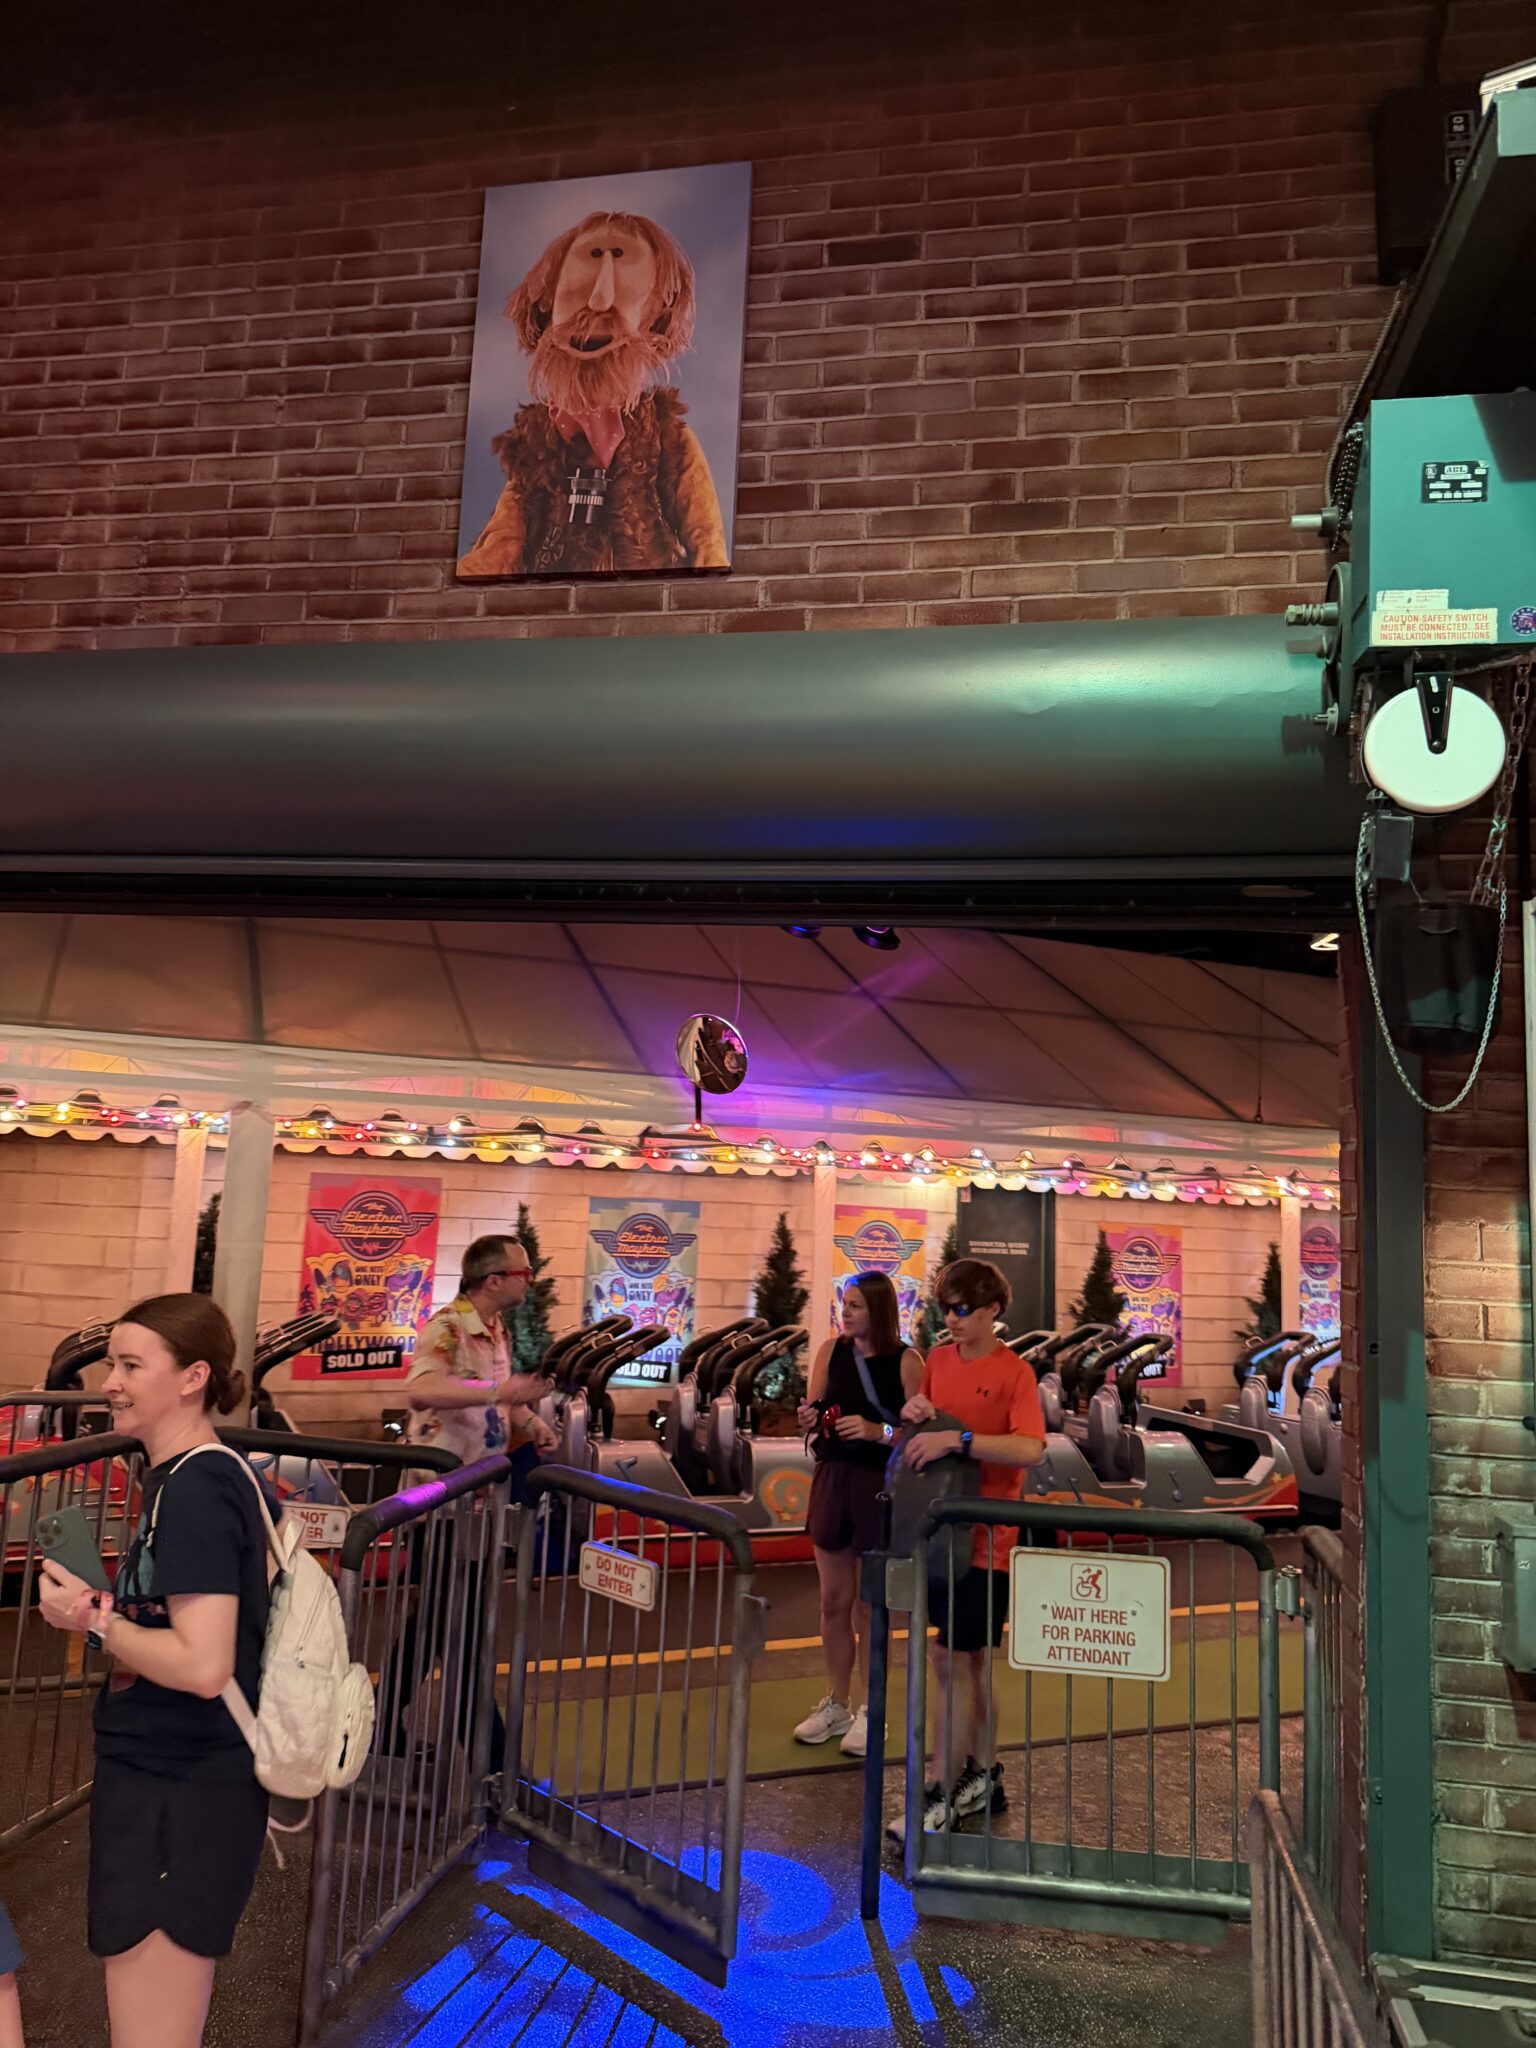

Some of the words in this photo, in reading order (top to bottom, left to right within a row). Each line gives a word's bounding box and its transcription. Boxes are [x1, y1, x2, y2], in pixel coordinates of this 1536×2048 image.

[1455, 613, 1488, 622] SWITCH
[1380, 623, 1404, 632] MUST
[1406, 623, 1416, 632] BE
[1474, 622, 1490, 630] SEE
[1380, 632, 1432, 641] INSTALLATION
[1434, 631, 1490, 640] INSTRUCTIONS
[343, 1211, 403, 1223] Electric
[341, 1222, 402, 1238] Mayhem
[618, 1231, 669, 1243] Electric
[616, 1242, 669, 1256] Mayhem
[327, 1352, 364, 1369] SOLD
[367, 1350, 397, 1366] OUT
[641, 1364, 668, 1379] OUT
[300, 1511, 328, 1525] NOT
[596, 1556, 611, 1572] DO
[614, 1562, 637, 1580] NOT
[597, 1573, 633, 1597] ENTER
[1051, 1605, 1086, 1622] WAIT
[1091, 1609, 1128, 1626] HERE
[1042, 1624, 1070, 1641] FOR
[1074, 1627, 1136, 1647] PARKING
[1047, 1645, 1131, 1667] ATTENDANT
